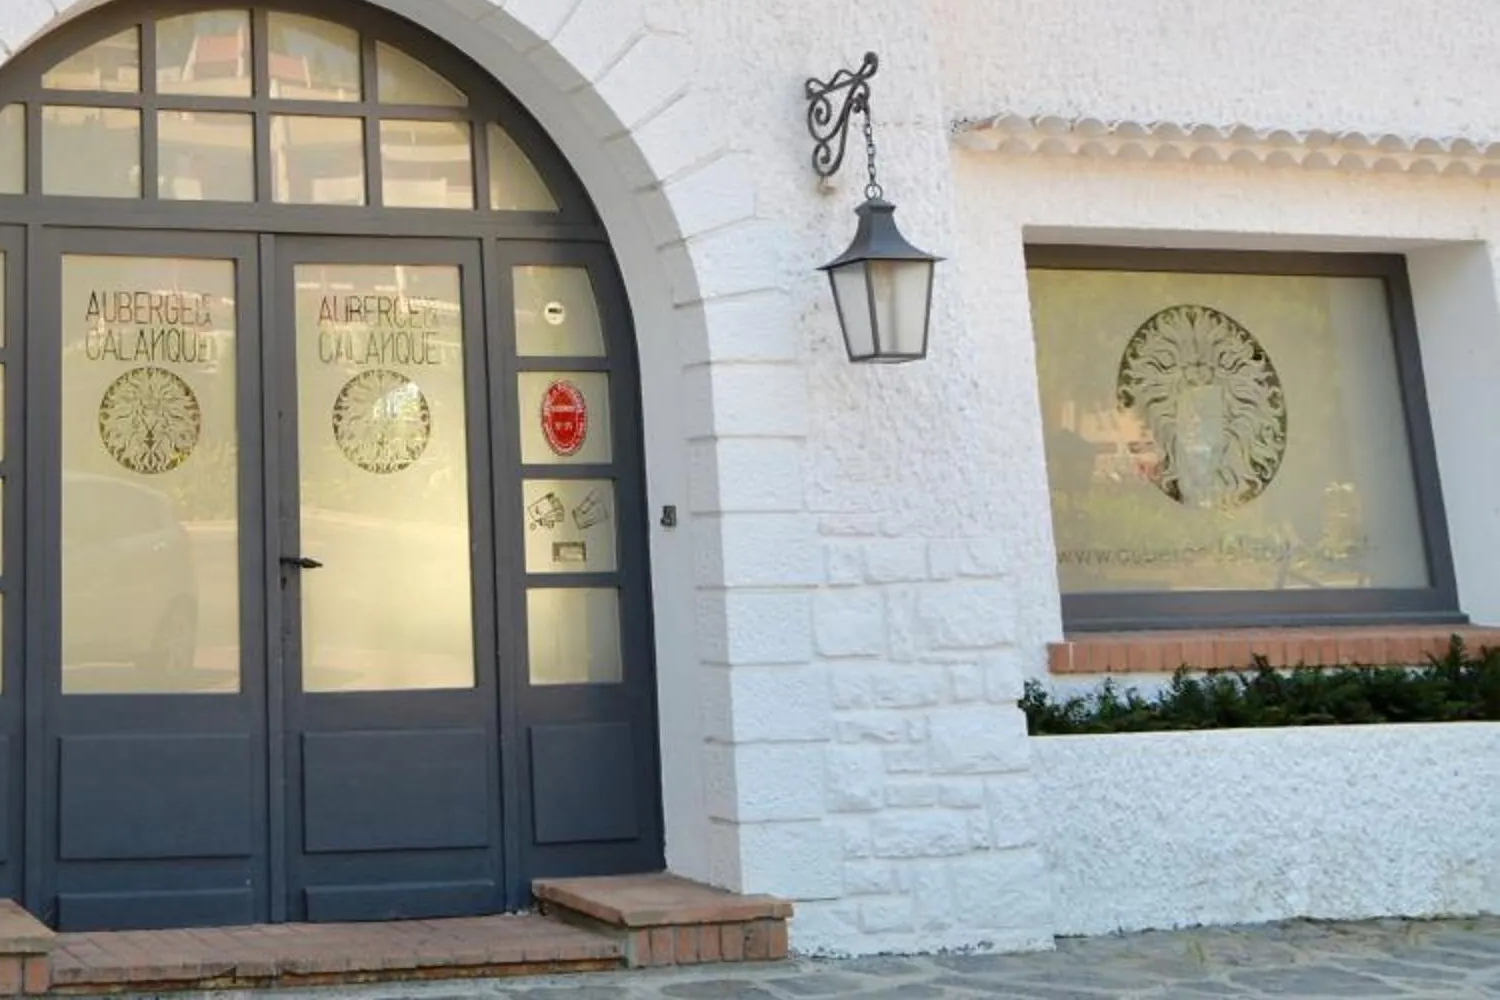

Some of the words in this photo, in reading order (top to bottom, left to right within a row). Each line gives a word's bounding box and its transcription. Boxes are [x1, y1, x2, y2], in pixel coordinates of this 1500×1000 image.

[85, 290, 196, 325] AUBERGE
[85, 328, 209, 362] CALANQUE
[318, 331, 442, 365] CALANQUE
